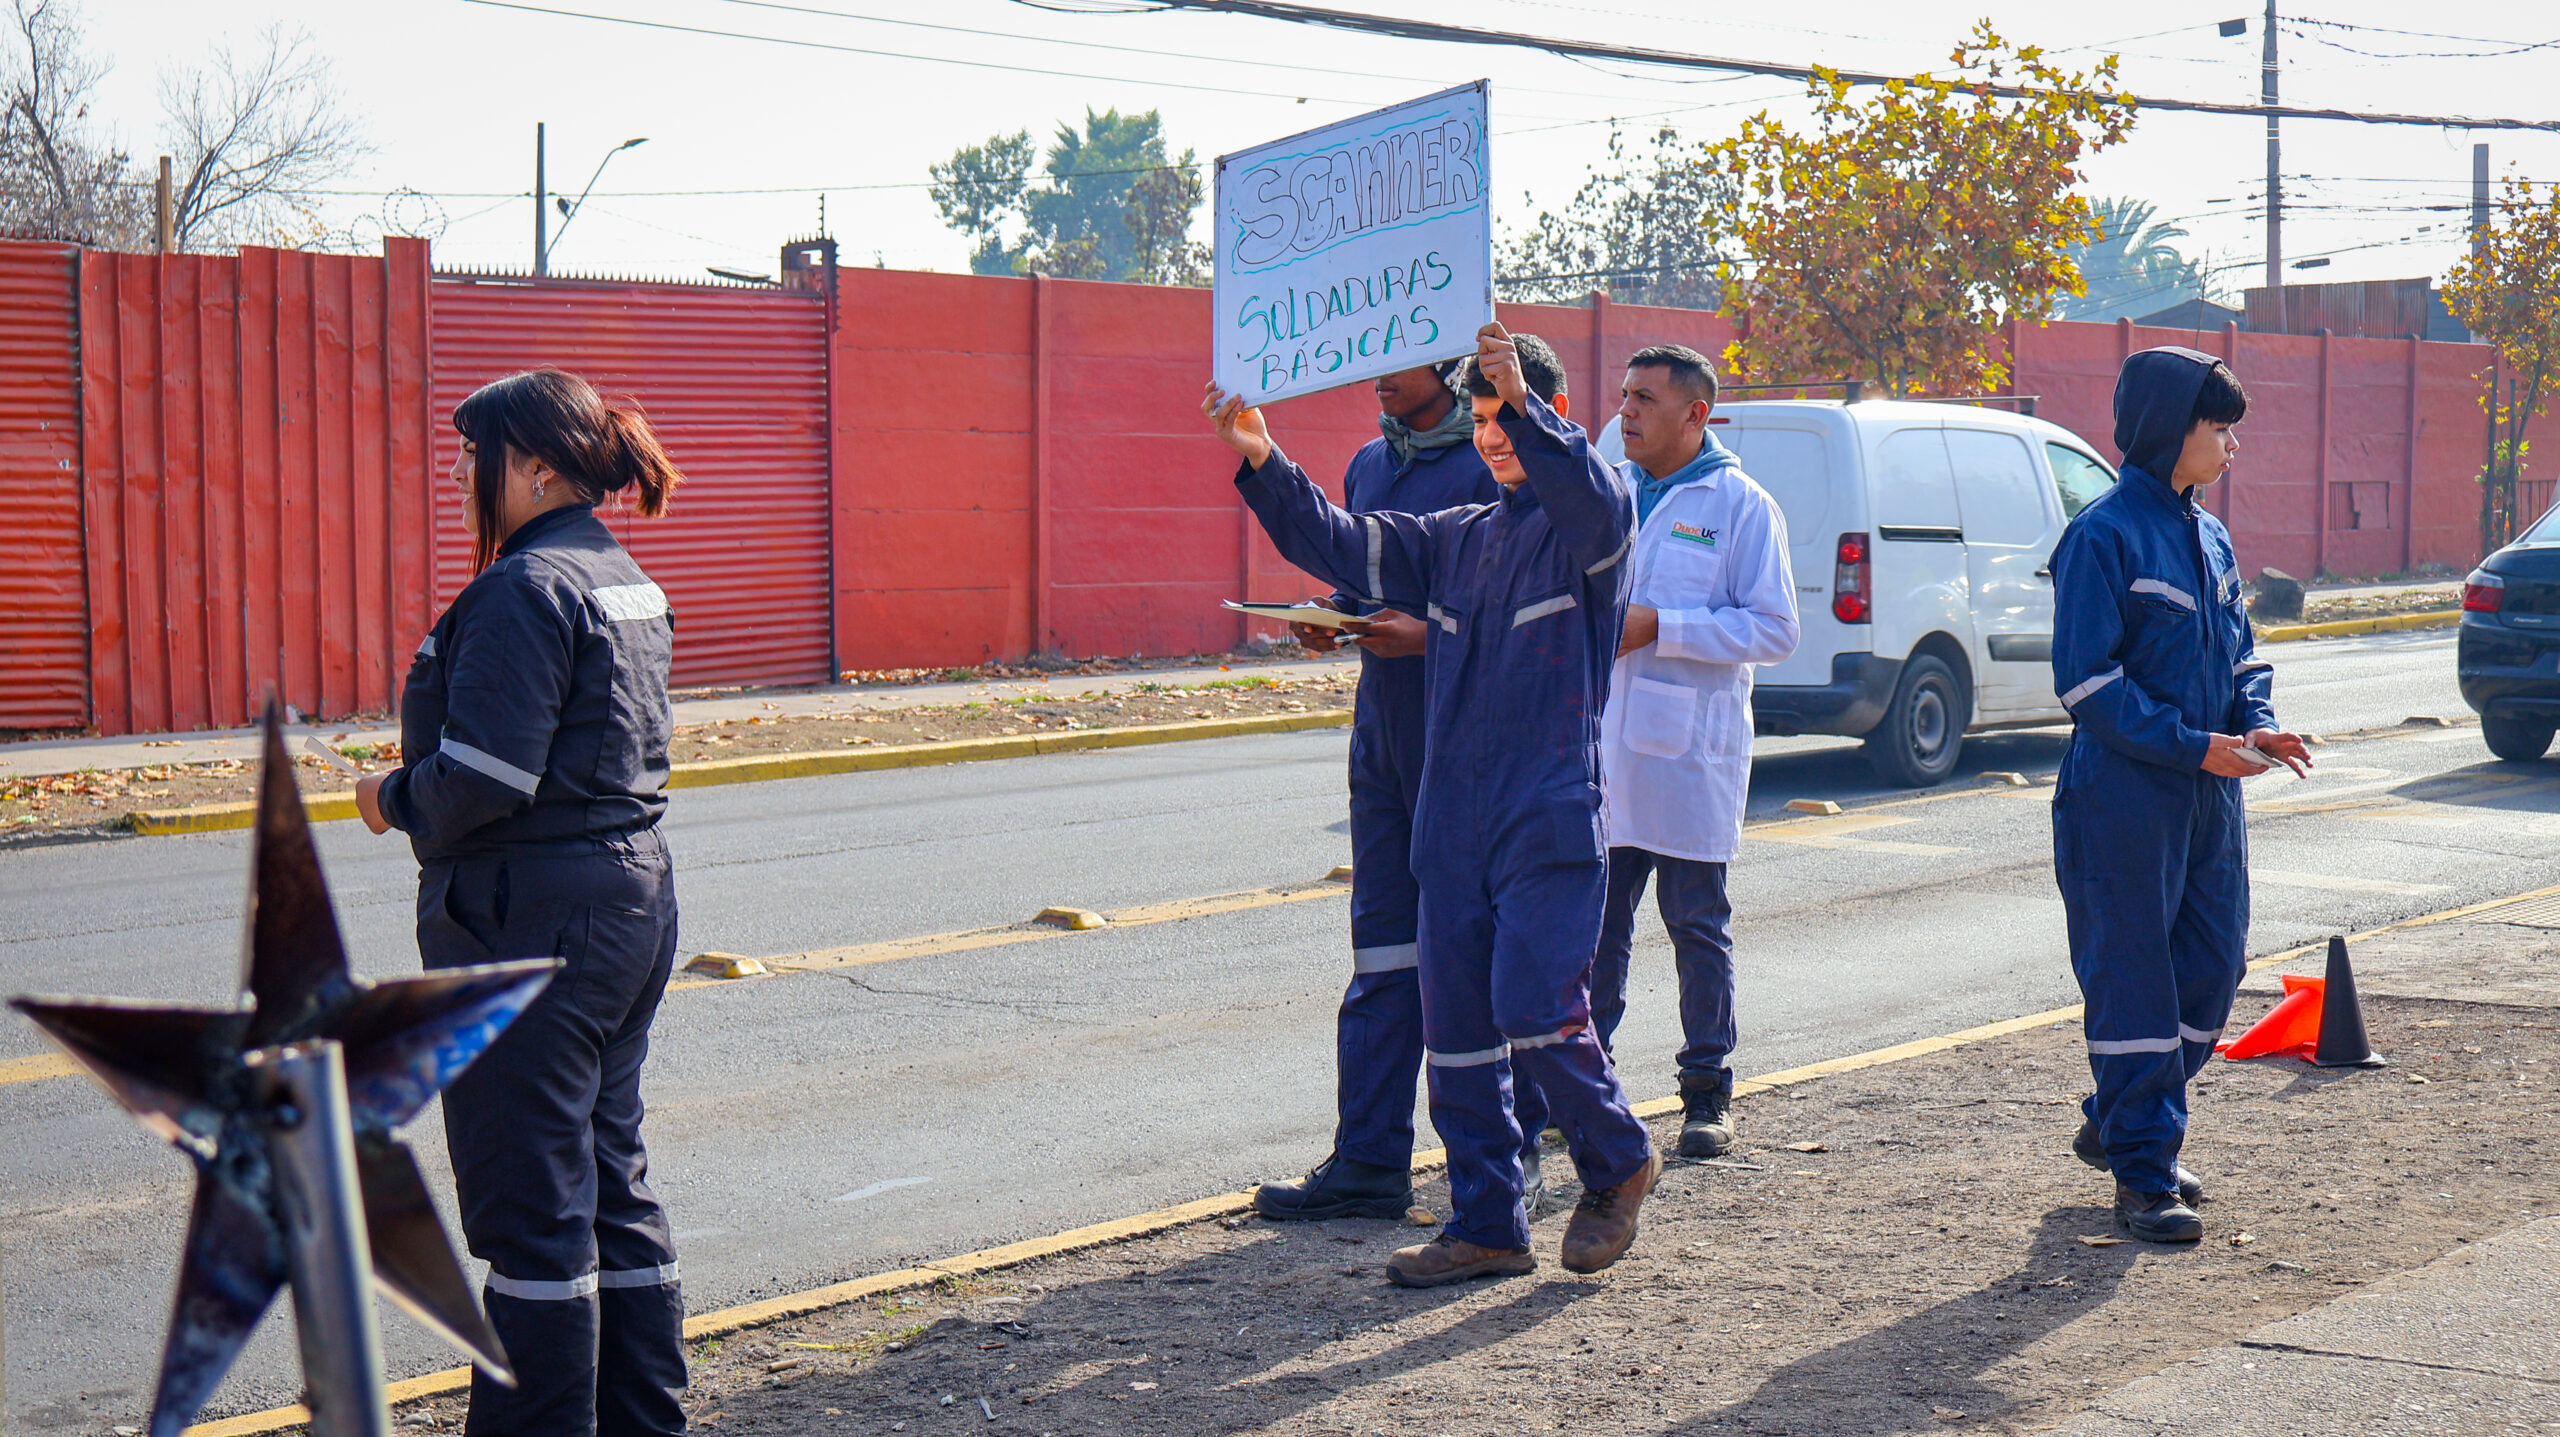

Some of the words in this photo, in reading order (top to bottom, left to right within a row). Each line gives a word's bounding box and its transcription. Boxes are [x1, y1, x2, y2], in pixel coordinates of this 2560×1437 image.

[1237, 119, 1479, 264] SCANNER
[1237, 251, 1452, 362] SOLDADURAS
[1261, 305, 1439, 393] BÁSICAS
